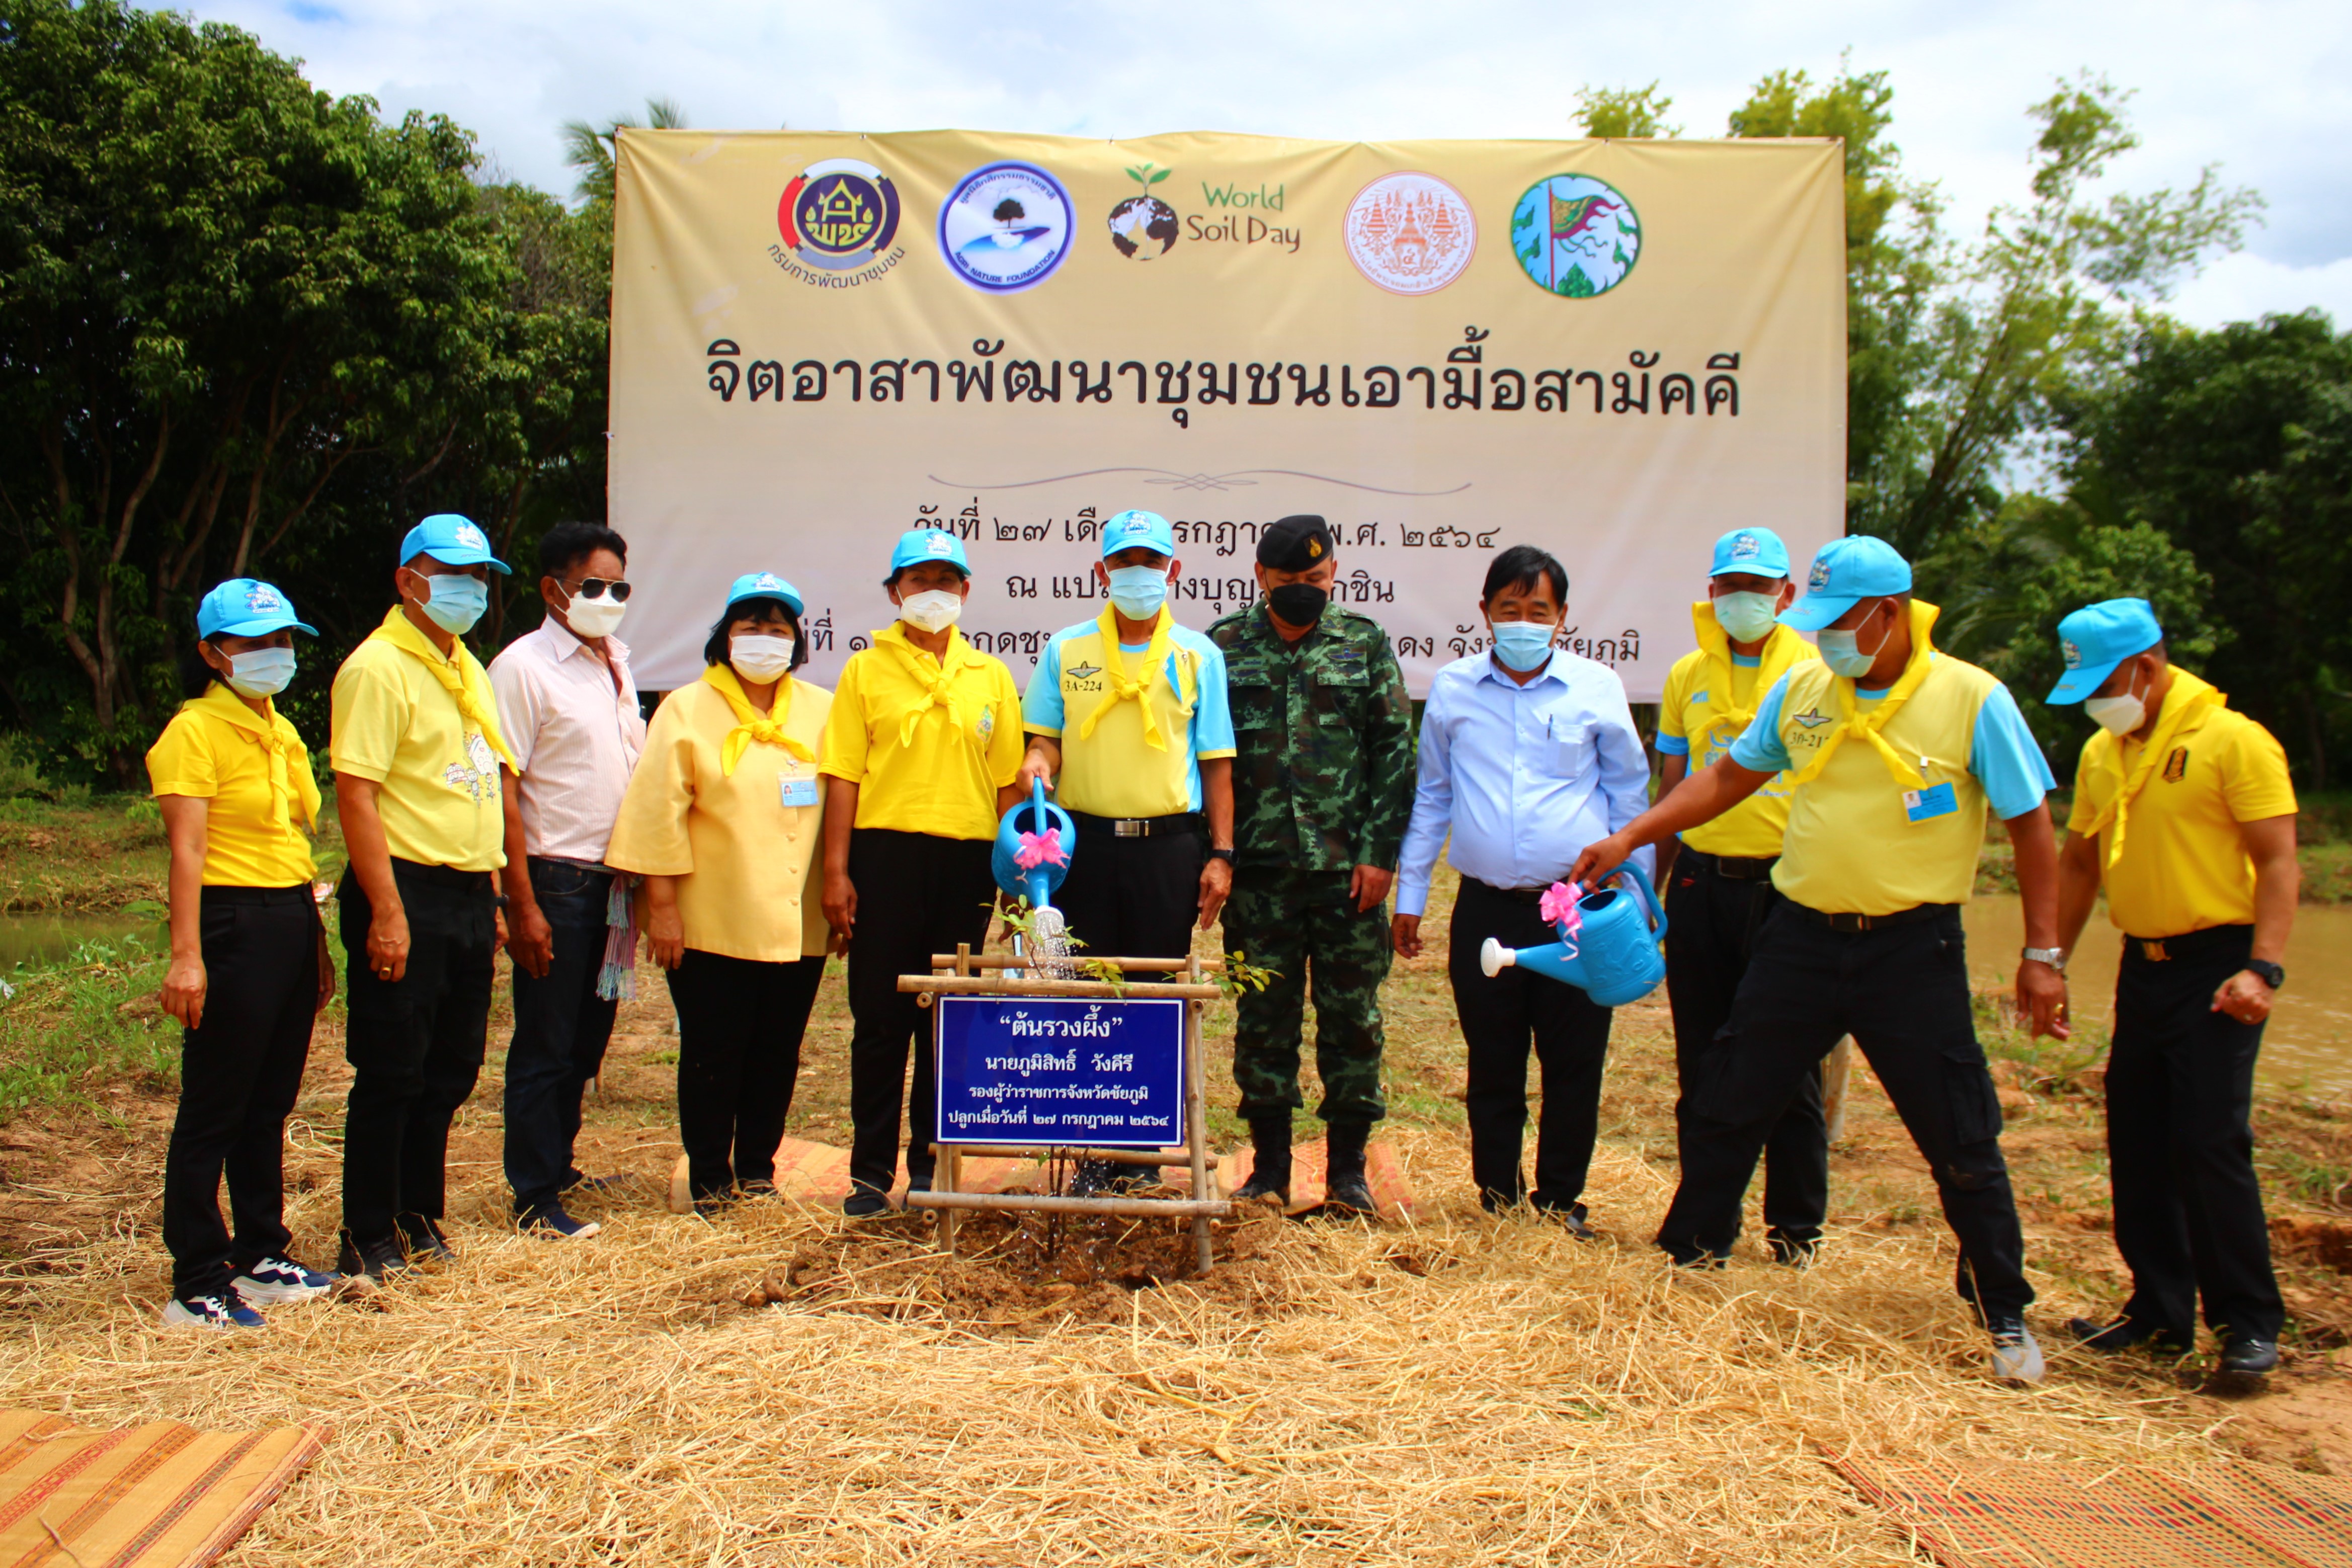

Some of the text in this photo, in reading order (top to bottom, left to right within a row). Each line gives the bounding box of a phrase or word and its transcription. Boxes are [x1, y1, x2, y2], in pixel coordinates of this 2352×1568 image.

[1202, 181, 1283, 212] World
[1186, 215, 1300, 254] Soil Day
[767, 243, 906, 288] กรมการพัฒนาชุมชน
[1007, 250, 1055, 283] FOUNDATION
[707, 326, 1740, 429] จิตอาสาพัฒนาชุมชนเอามื้อสามัคคี
[993, 518, 1052, 542] ๒๗
[1401, 522, 1501, 548] ๒๕๖๔
[1006, 576, 1037, 598] ณ
[1065, 680, 1102, 692] 3A-224
[1000, 1004, 1123, 1037] “ต้นรวงผึ้ง”
[985, 1048, 1077, 1077] นายภูมิสิทธิ์
[968, 1083, 1149, 1105] รองผู้ว่าราชการจังหวัดชัยภูมิ
[948, 1105, 1169, 1129] ปลูกเมื่อวันที่ ๒๗ กรกฎาคม ๒๕๖๔
